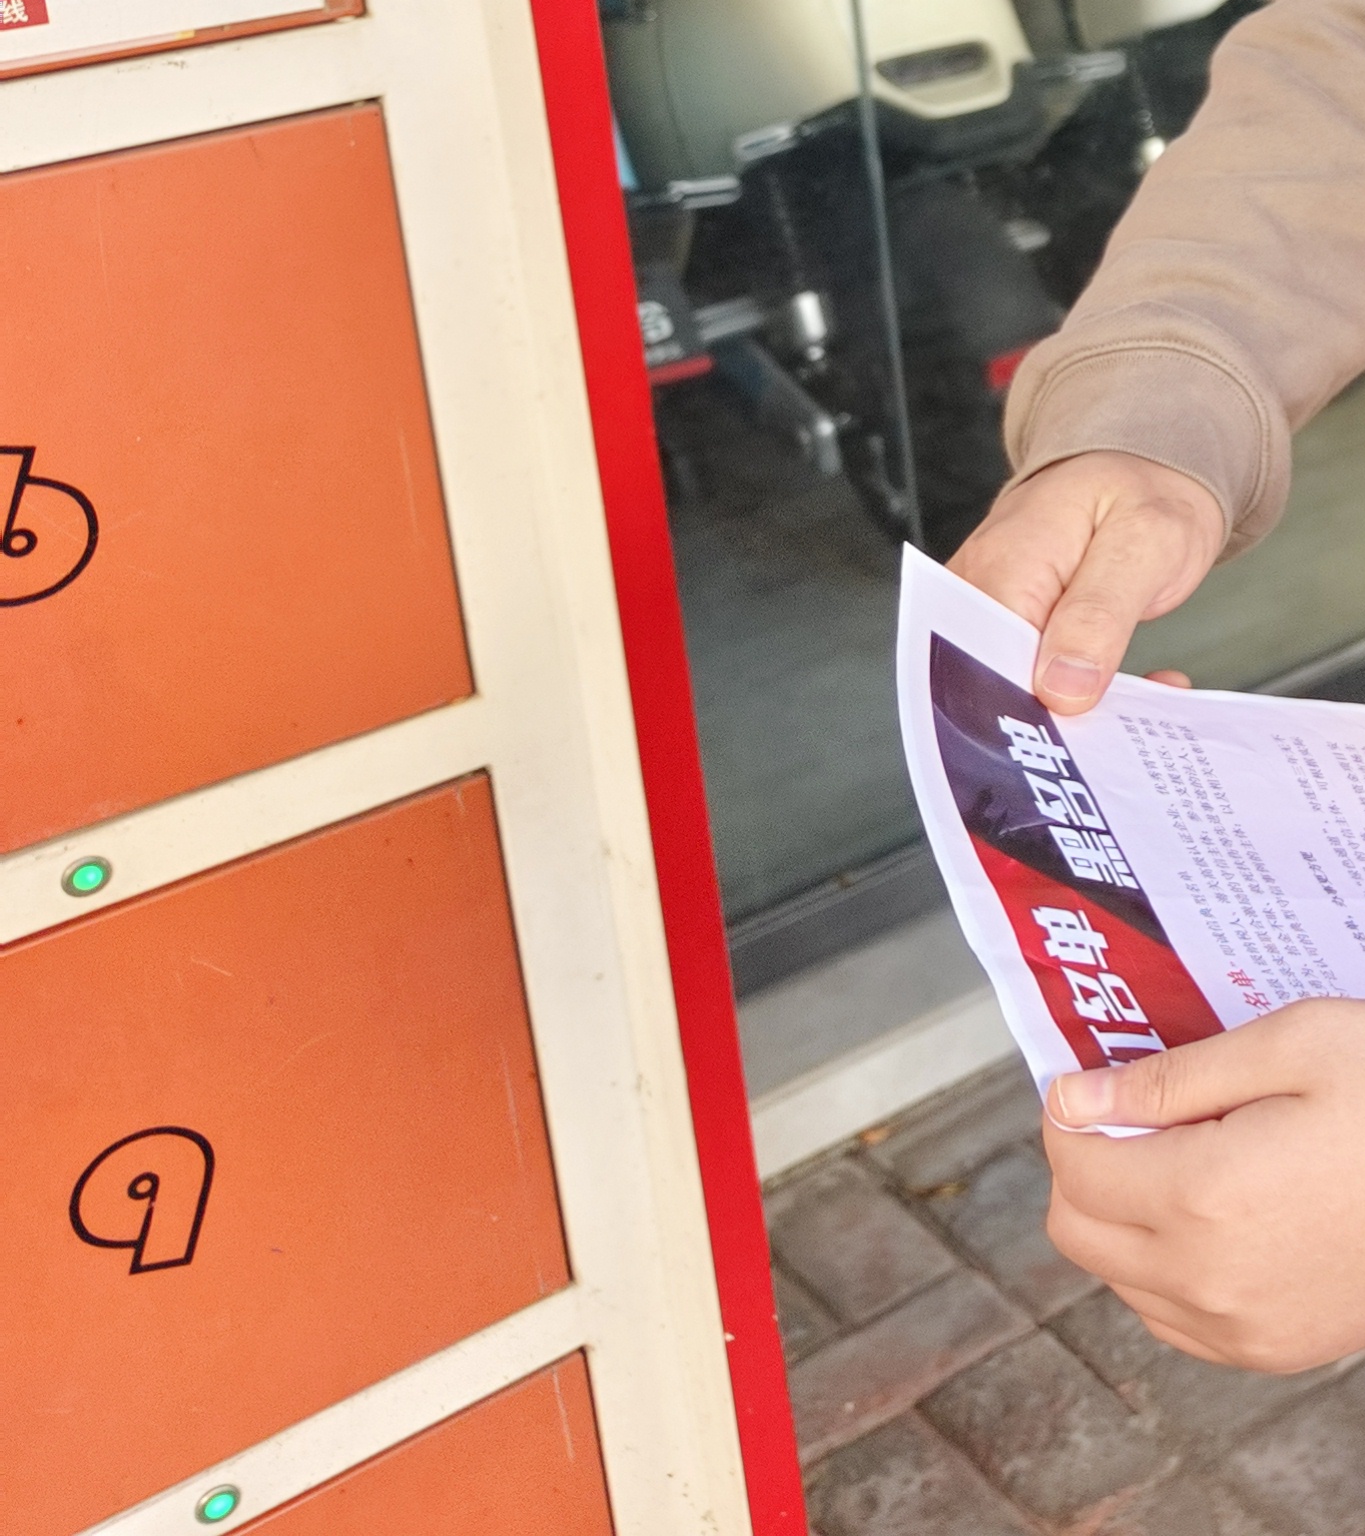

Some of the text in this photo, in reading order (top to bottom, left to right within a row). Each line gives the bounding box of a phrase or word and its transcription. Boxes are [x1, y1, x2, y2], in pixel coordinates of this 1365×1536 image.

[997, 714, 1141, 891] 黑名单
[1226, 961, 1271, 1015] 名单”
[68, 1124, 215, 1276] 9
